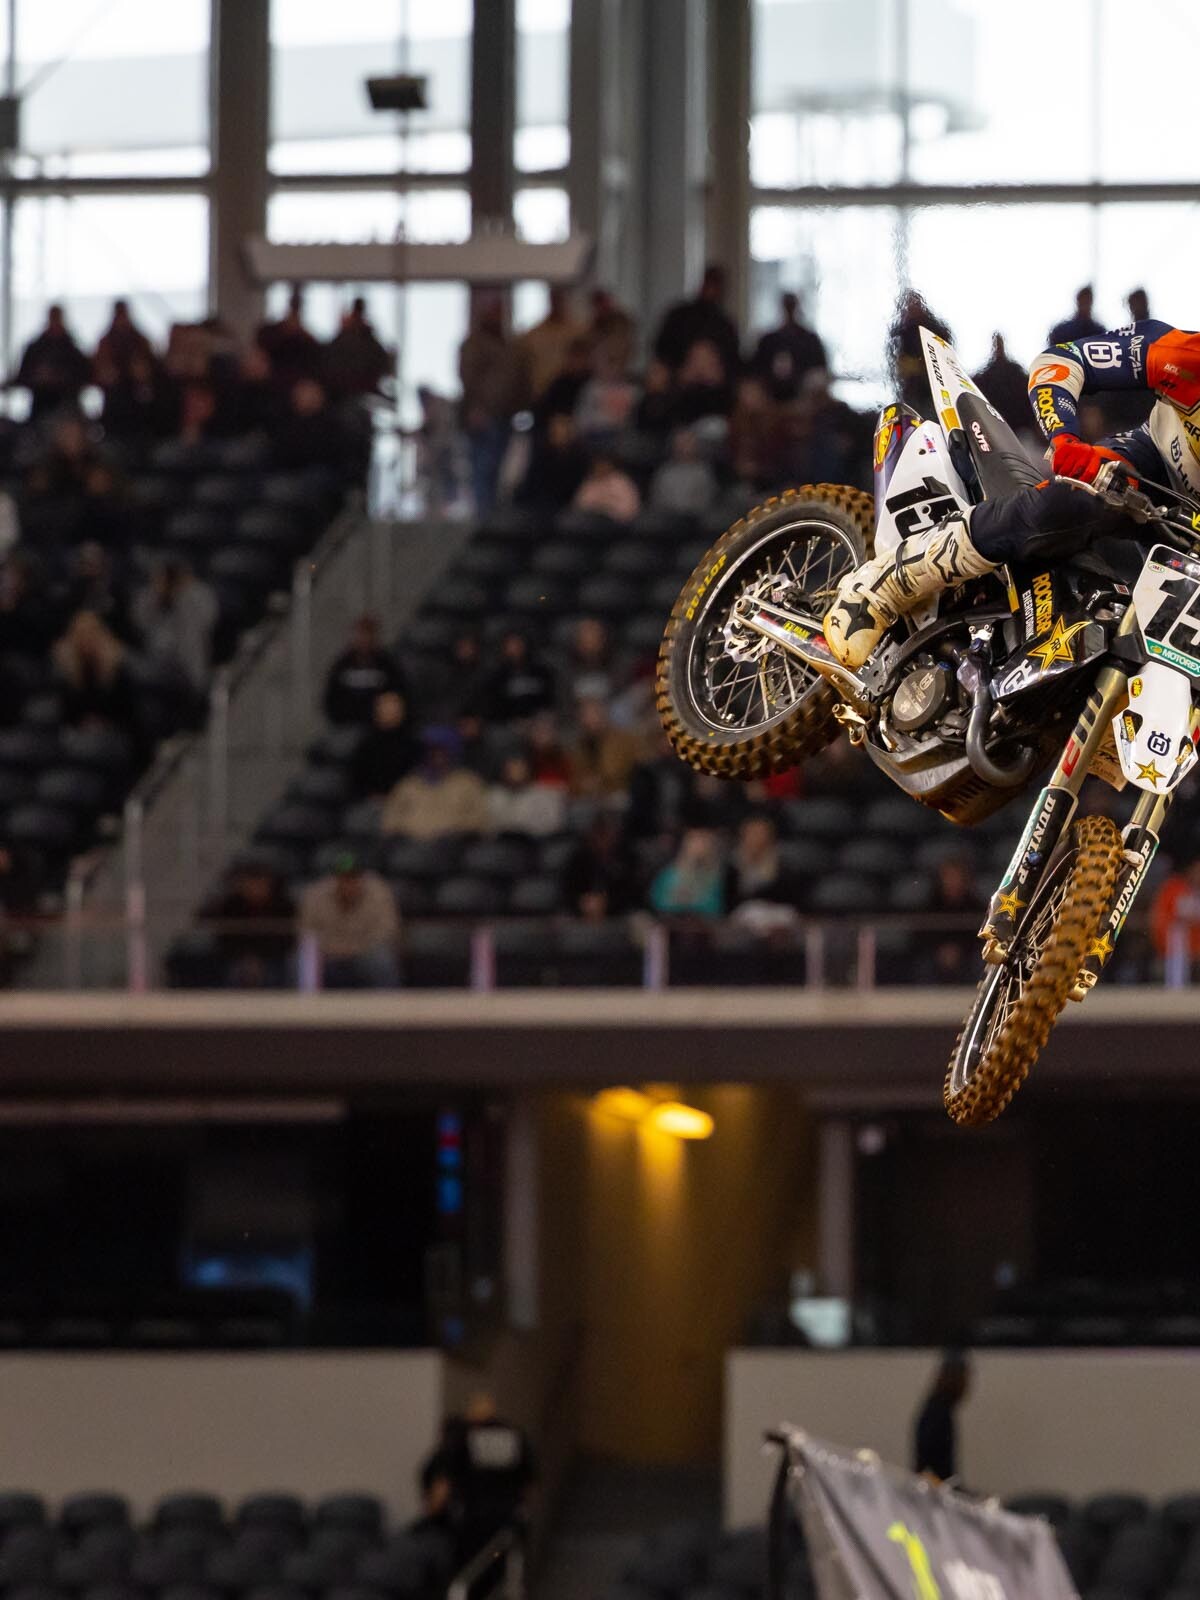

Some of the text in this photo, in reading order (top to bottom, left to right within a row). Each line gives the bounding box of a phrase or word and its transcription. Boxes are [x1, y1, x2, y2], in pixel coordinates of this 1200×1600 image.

[927, 342, 945, 387] DUNLOP
[971, 420, 991, 453] GUTS
[685, 554, 728, 621] DUNLOP
[1032, 572, 1053, 638] ROCKSTAR
